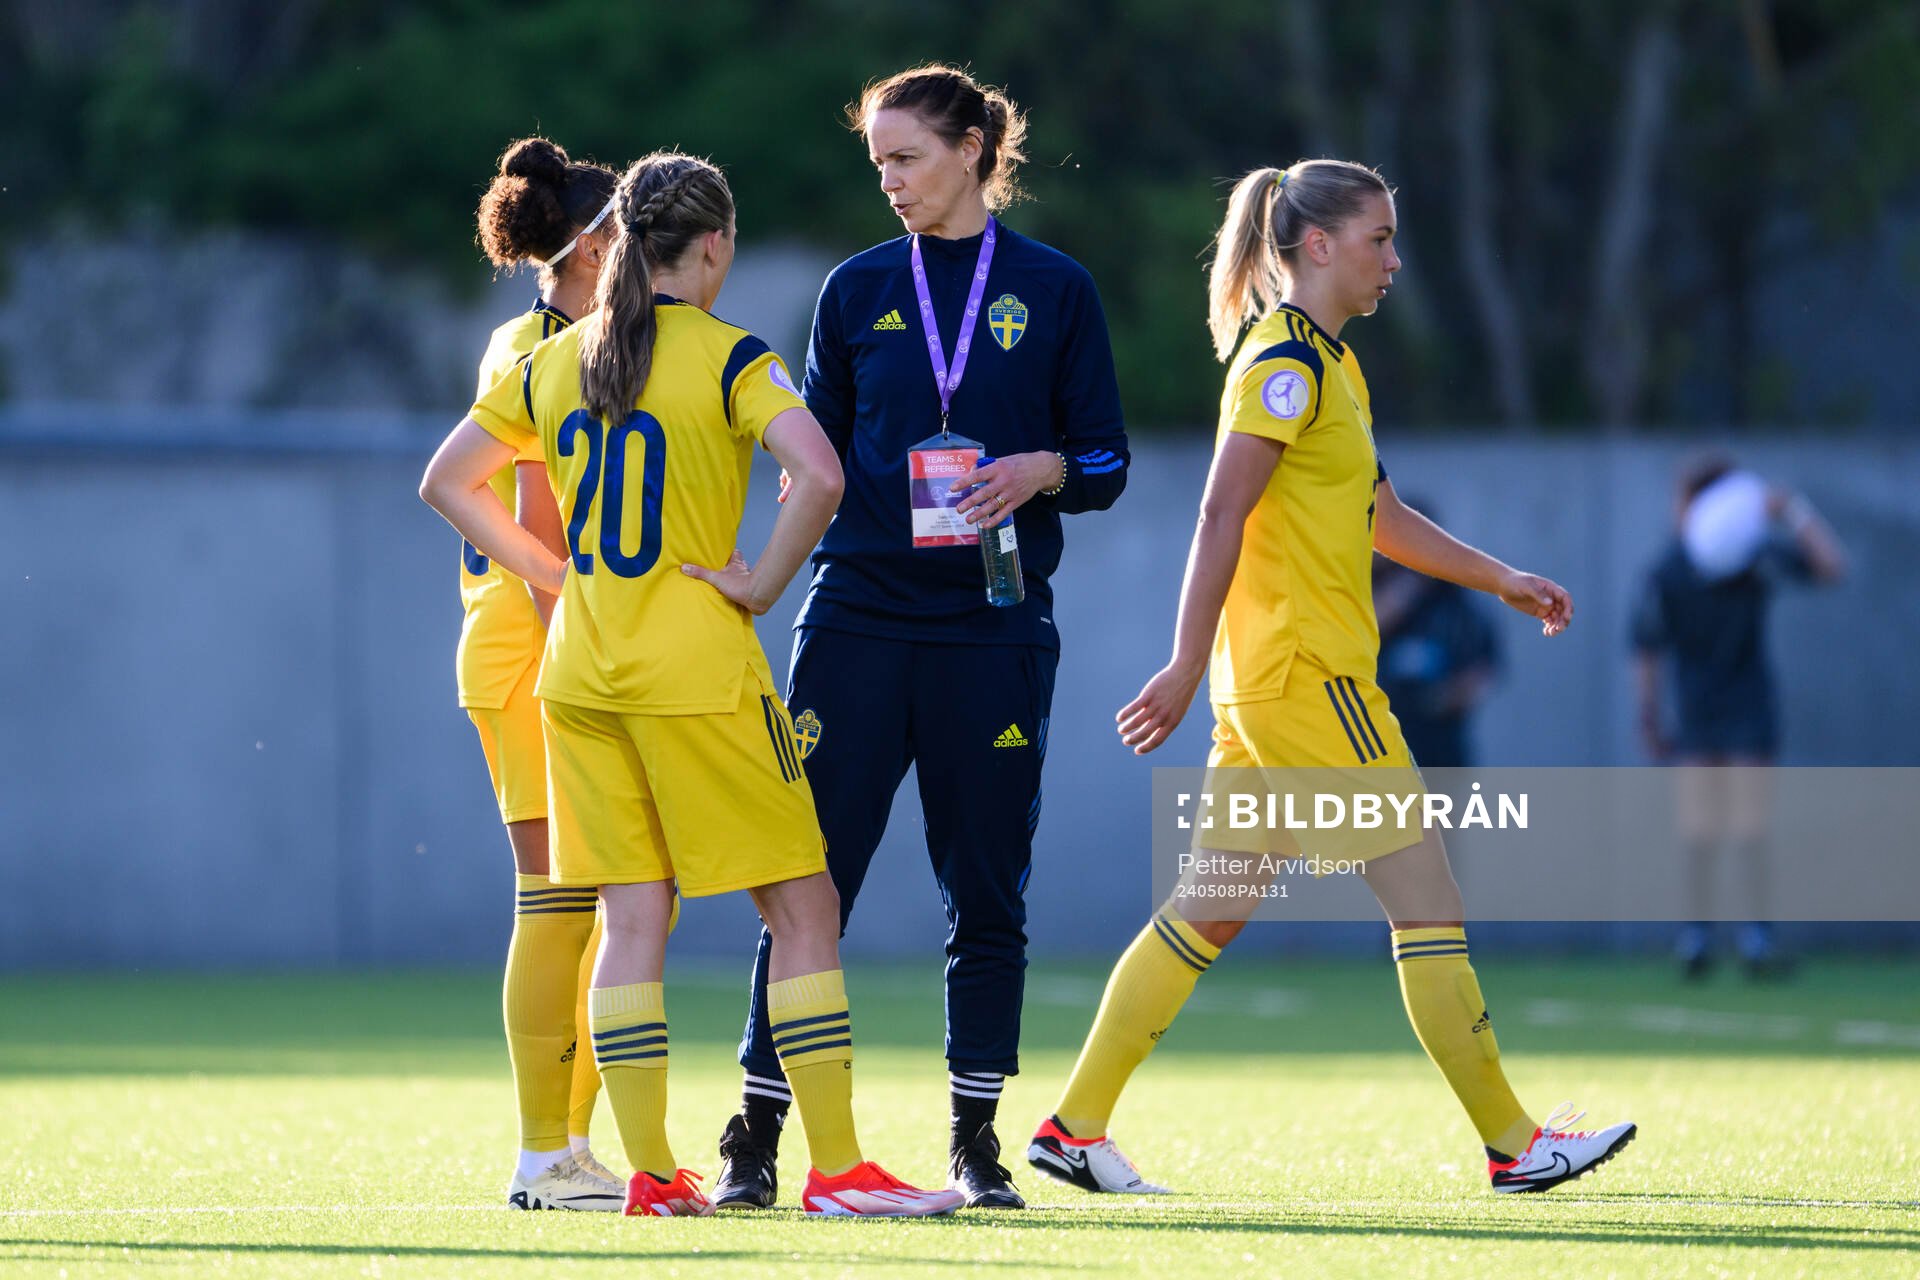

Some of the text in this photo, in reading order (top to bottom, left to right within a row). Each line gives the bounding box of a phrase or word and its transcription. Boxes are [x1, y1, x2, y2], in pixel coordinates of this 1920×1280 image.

[873, 322, 906, 331] adidas
[927, 455, 963, 464] TEAMS &
[924, 464, 966, 473] REFEREES
[558, 409, 666, 578] 20
[993, 737, 1028, 748] adidas
